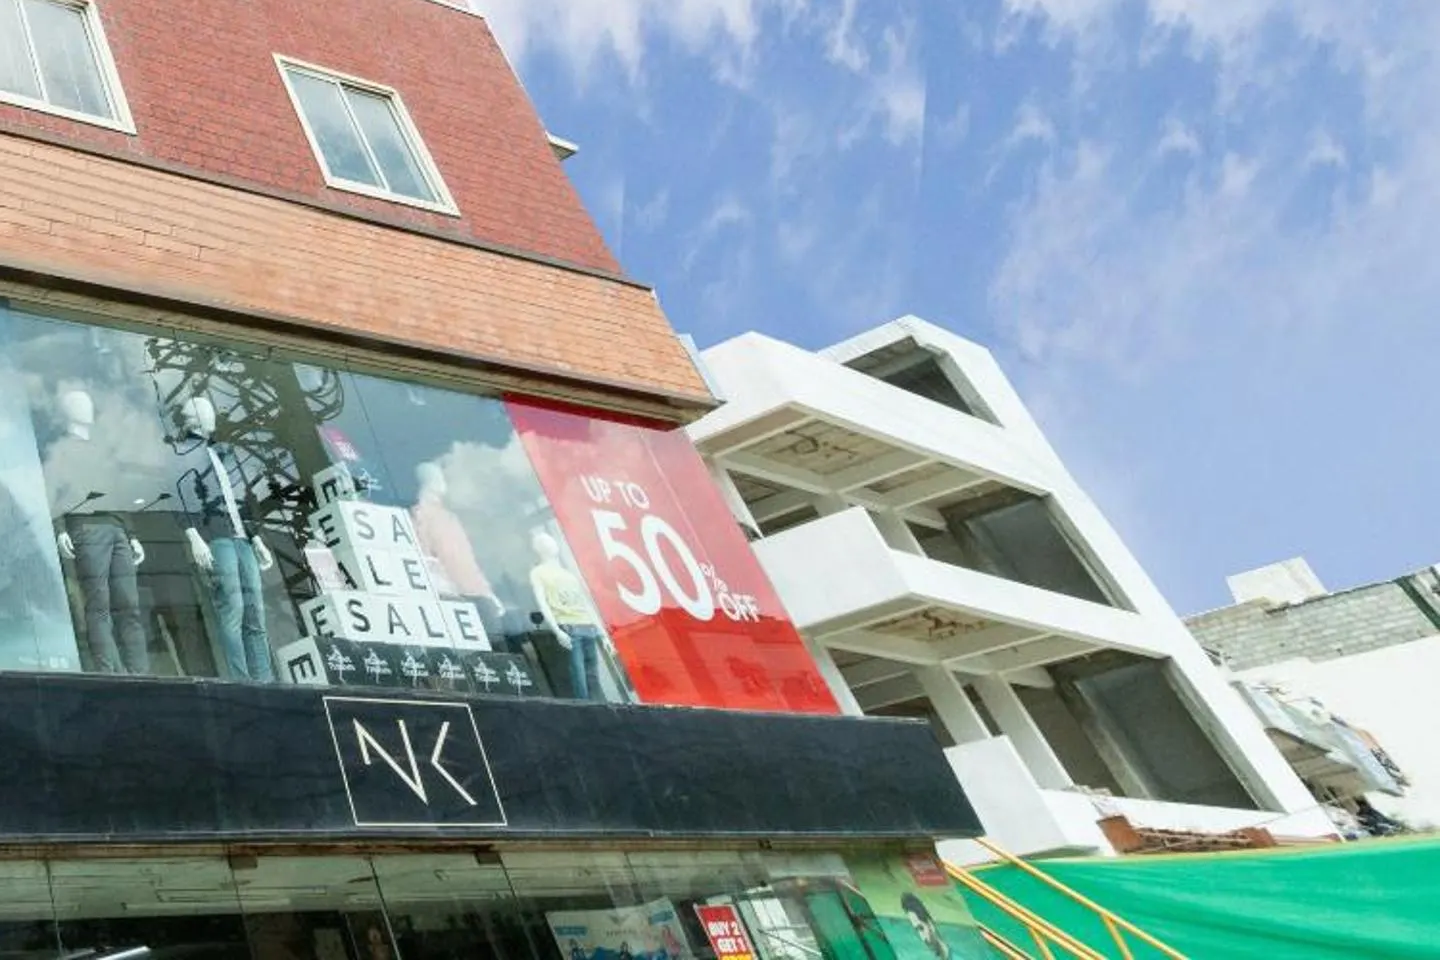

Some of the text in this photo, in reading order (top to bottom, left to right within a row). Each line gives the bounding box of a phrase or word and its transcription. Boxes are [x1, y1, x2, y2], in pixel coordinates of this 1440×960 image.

[580, 474, 650, 510] UP TO
[346, 598, 481, 642] SALE
[718, 591, 760, 623] OFF
[352, 717, 478, 807] NK
